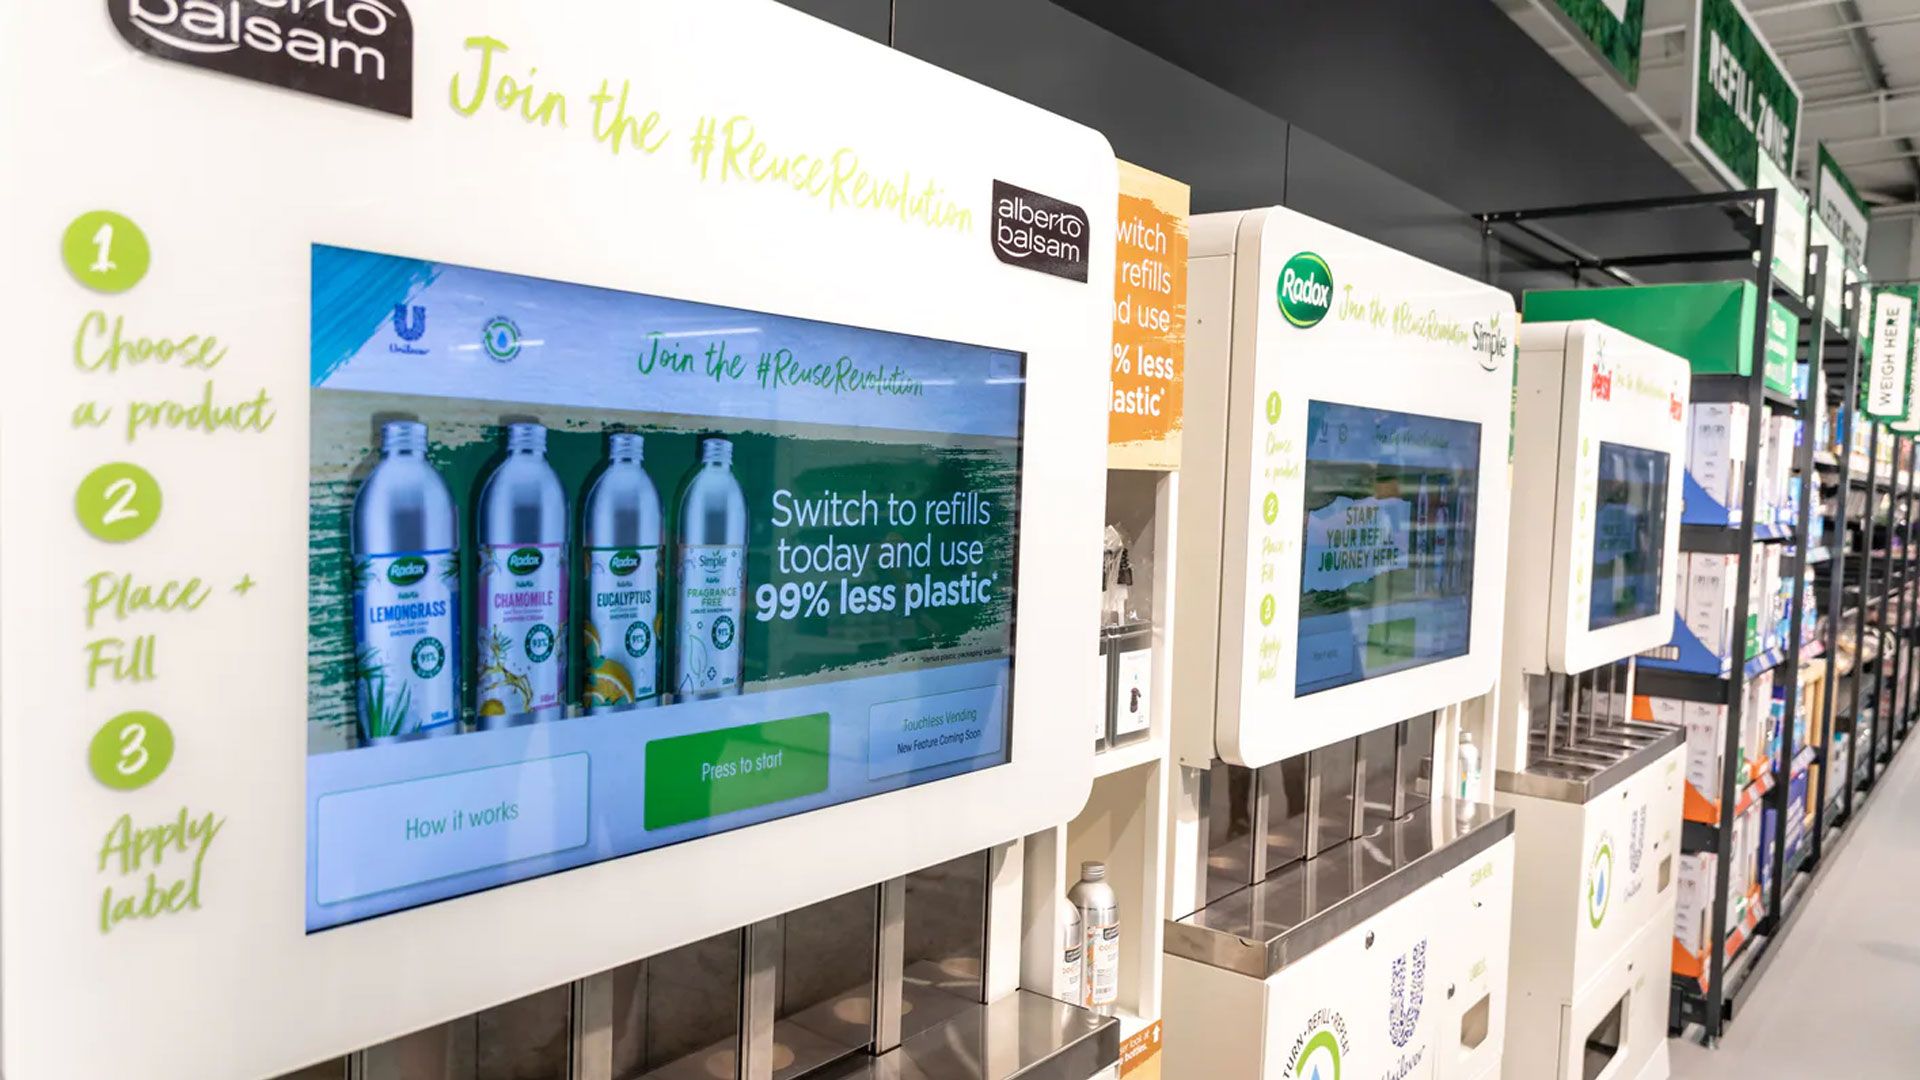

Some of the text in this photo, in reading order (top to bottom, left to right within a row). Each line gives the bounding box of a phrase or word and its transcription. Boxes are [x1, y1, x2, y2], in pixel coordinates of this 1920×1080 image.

[1708, 30, 1754, 134] REFILL
[449, 35, 973, 233] Join the #ReuseRevolution
[998, 197, 1085, 238] alberto
[1117, 216, 1167, 255] witch
[90, 223, 117, 273] 1
[998, 218, 1081, 263] balsam
[1122, 259, 1172, 294] refills
[1282, 268, 1330, 308] Radox
[1137, 303, 1171, 332] use
[1338, 283, 1365, 321] Join
[1368, 296, 1388, 329] the
[73, 309, 230, 373] Choose
[1471, 321, 1508, 362] Simple
[1879, 307, 1900, 406] WEIGH HERE
[638, 332, 923, 396] Join the #ReuseRevolution
[1137, 345, 1175, 381] less
[72, 379, 278, 444] a product
[1108, 381, 1166, 417] lastic
[102, 477, 140, 525] 2
[771, 489, 991, 528] Switch to refills
[1346, 506, 1379, 526] START
[778, 533, 984, 578] today and use
[1327, 529, 1357, 549] YOUR
[390, 563, 425, 577] Radox
[509, 554, 540, 568] Radox
[611, 556, 638, 568] Radox
[699, 554, 727, 569] Simple
[1318, 548, 1399, 572] JOURNEY HERE
[85, 571, 212, 629] Place
[369, 601, 447, 623] LEMONGRASS
[494, 591, 554, 608] CHAMOMILE
[597, 590, 652, 607] EUCALYPTUS
[687, 587, 737, 598] FRAGRANCE
[701, 597, 723, 607] FREE
[755, 580, 831, 622] 99%
[840, 578, 897, 615] less
[84, 634, 157, 690] Fill
[902, 708, 977, 732] Touchless Vending
[117, 723, 149, 775] 3
[897, 729, 982, 754] New Feature Coming Soon
[702, 749, 783, 782] Press to start
[98, 805, 227, 875] Apply
[406, 801, 519, 840] How it works
[100, 863, 201, 933] label
[1282, 1033, 1303, 1078] TURN
[1307, 1008, 1330, 1034] REFILL
